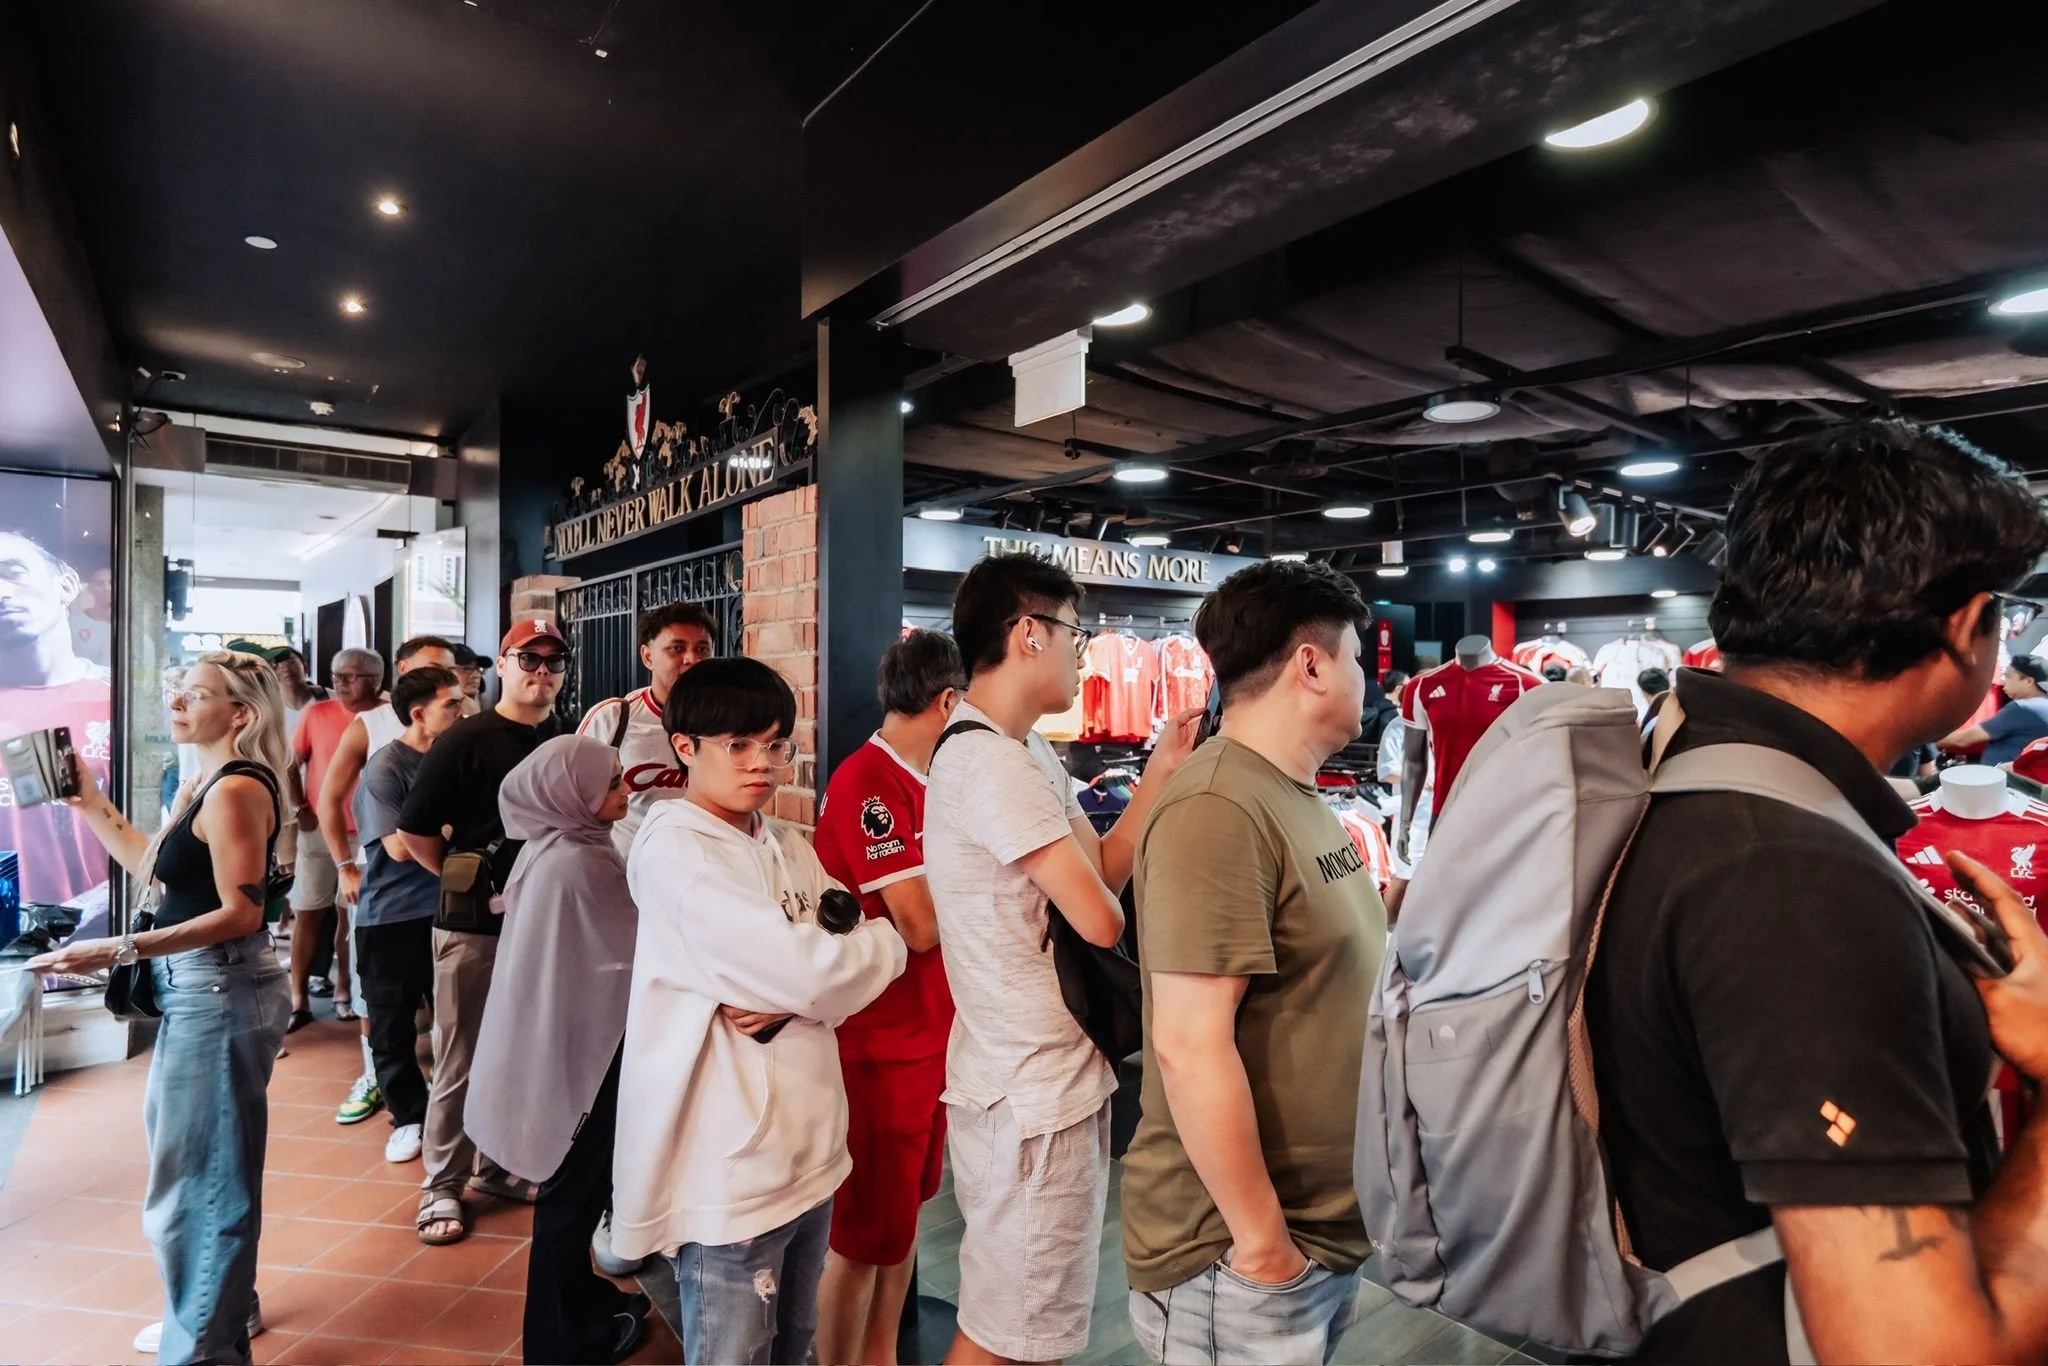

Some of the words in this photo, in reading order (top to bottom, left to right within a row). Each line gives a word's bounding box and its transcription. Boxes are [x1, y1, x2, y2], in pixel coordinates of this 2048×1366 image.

[597, 497, 646, 545] NEVER
[648, 474, 694, 526] WALK
[698, 437, 776, 509] ALONE
[1051, 544, 1141, 578] MEANS
[1147, 554, 1211, 583] MORE
